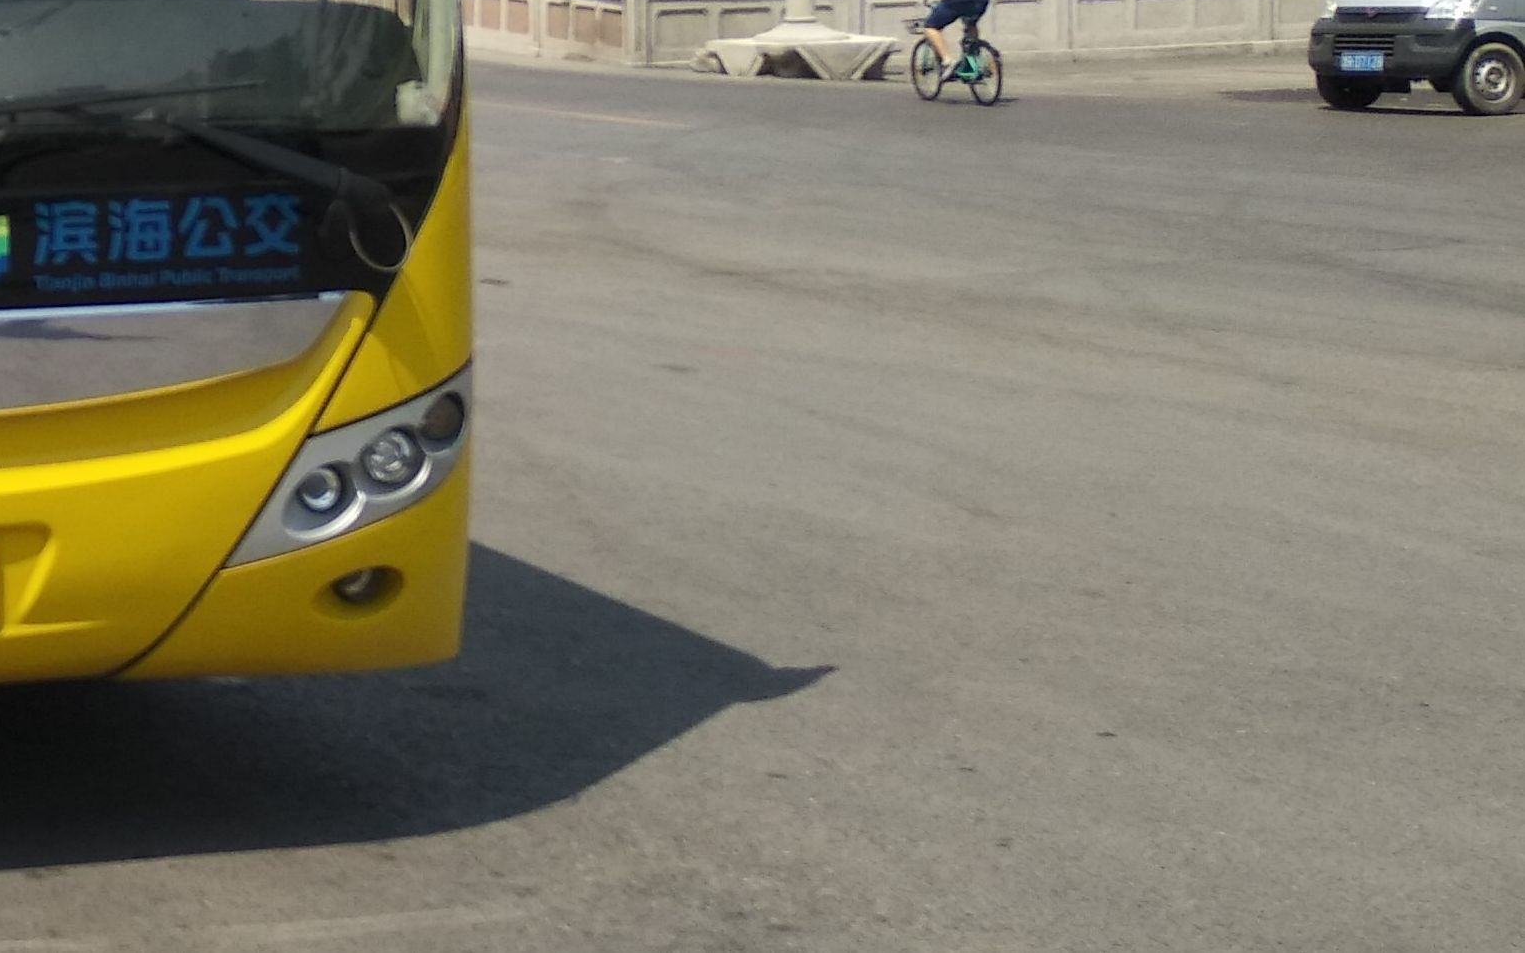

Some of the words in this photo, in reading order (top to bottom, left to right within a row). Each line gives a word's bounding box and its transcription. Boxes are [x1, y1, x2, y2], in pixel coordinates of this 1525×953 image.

[33, 194, 301, 265] 滨海公交
[33, 274, 96, 293] Tianjin
[99, 272, 157, 289] Binhai
[159, 268, 213, 287] Public
[216, 264, 300, 285] Transport
